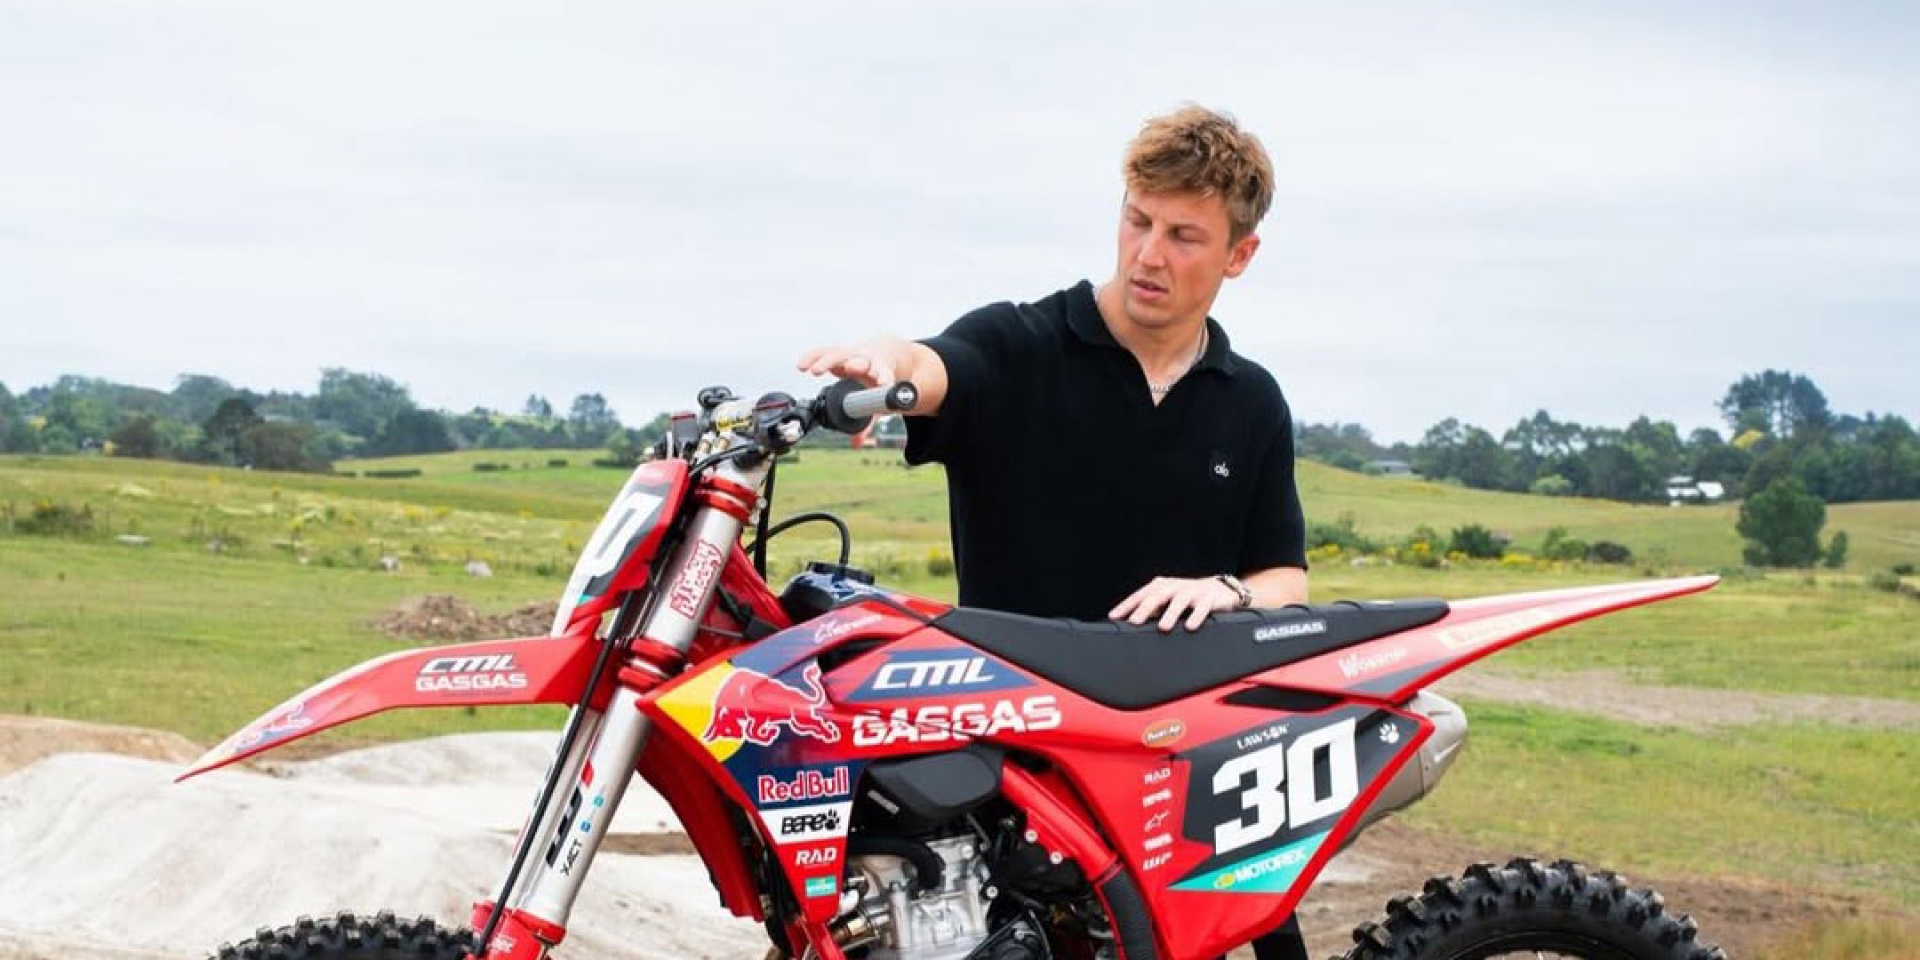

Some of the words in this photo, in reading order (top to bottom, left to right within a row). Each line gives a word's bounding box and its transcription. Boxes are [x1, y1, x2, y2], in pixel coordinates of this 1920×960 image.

[1254, 620, 1327, 642] GASGAS
[419, 653, 514, 673] CML
[872, 657, 996, 690] CML
[415, 672, 527, 691] GASGAS
[852, 695, 1062, 746] GASGAS
[757, 775, 806, 803] Red
[805, 765, 850, 797] Bull
[1211, 716, 1360, 856] 30
[795, 846, 838, 866] RAD
[1234, 846, 1306, 882] MOTOREX
